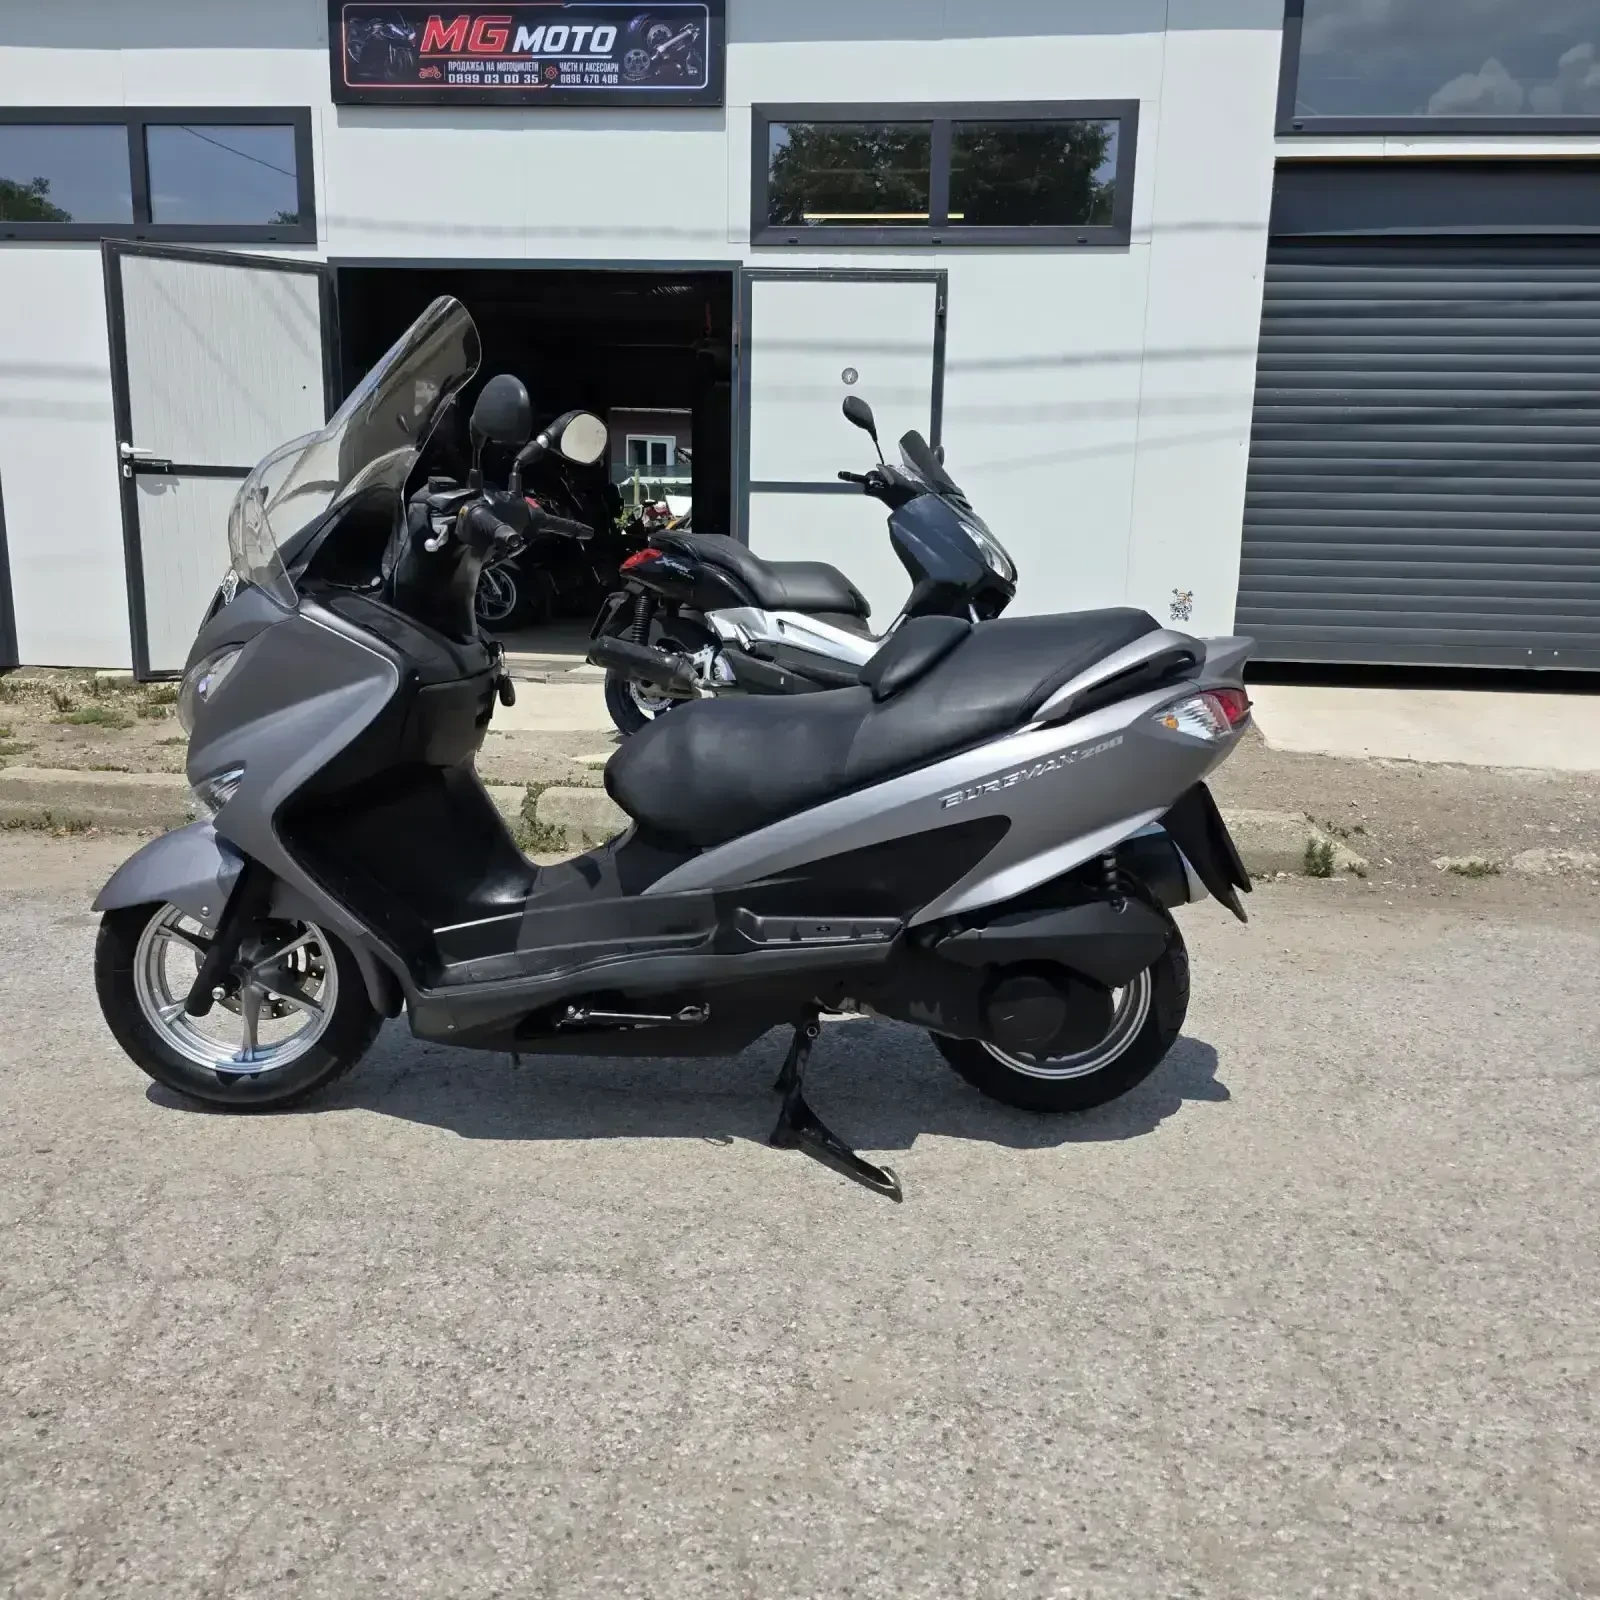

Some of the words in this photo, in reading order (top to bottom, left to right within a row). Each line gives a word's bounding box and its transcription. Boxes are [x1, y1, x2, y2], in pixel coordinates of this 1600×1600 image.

[420, 15, 512, 52] MG
[512, 26, 617, 52] MOTO
[448, 61, 485, 72] ПРОДАЖБА
[486, 61, 495, 72] НА
[497, 62, 539, 72] МОТОЦИКЛЕТИ
[560, 62, 578, 72] ЧАСТИ
[579, 62, 584, 72] И
[585, 62, 619, 73] АКСЕСОАРИ
[448, 73, 480, 84] 0899
[484, 73, 499, 84] 03
[504, 74, 519, 84] 00
[523, 74, 539, 84] 35
[583, 74, 600, 84] 470
[602, 74, 618, 84] 406
[938, 750, 1078, 809] BURGMAN
[1079, 735, 1124, 761] 200
